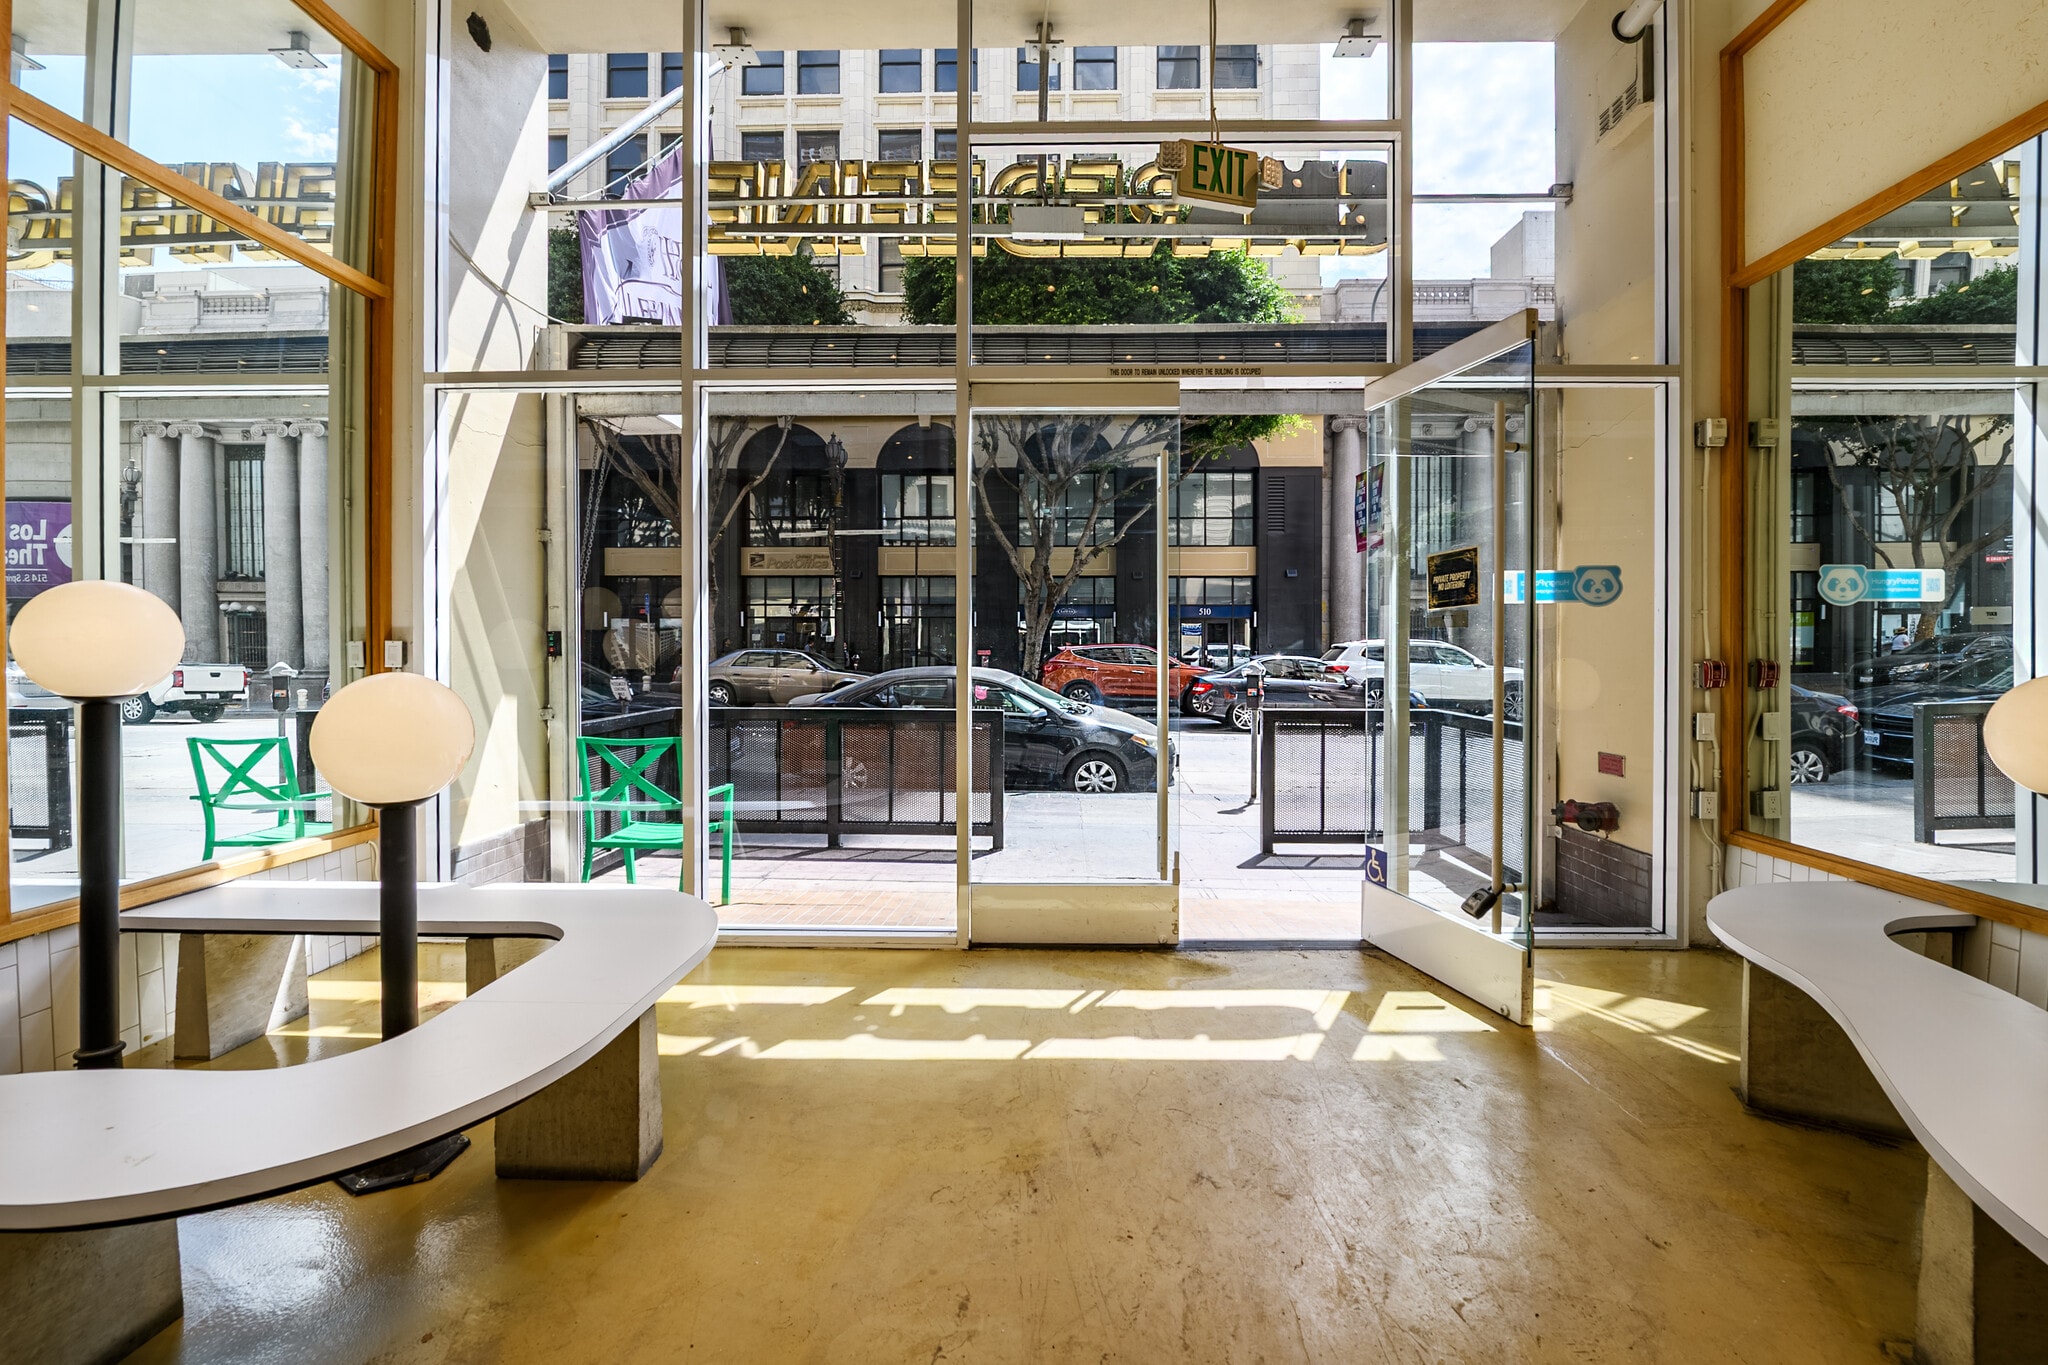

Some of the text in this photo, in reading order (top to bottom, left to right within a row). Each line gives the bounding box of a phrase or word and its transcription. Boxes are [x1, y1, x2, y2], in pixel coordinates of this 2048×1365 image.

[1193, 146, 1249, 197] EXIT
[1433, 571, 1471, 584] PRIVATE PROPERTY
[1438, 580, 1465, 591] NO LOITERING
[1198, 608, 1212, 616] 510
